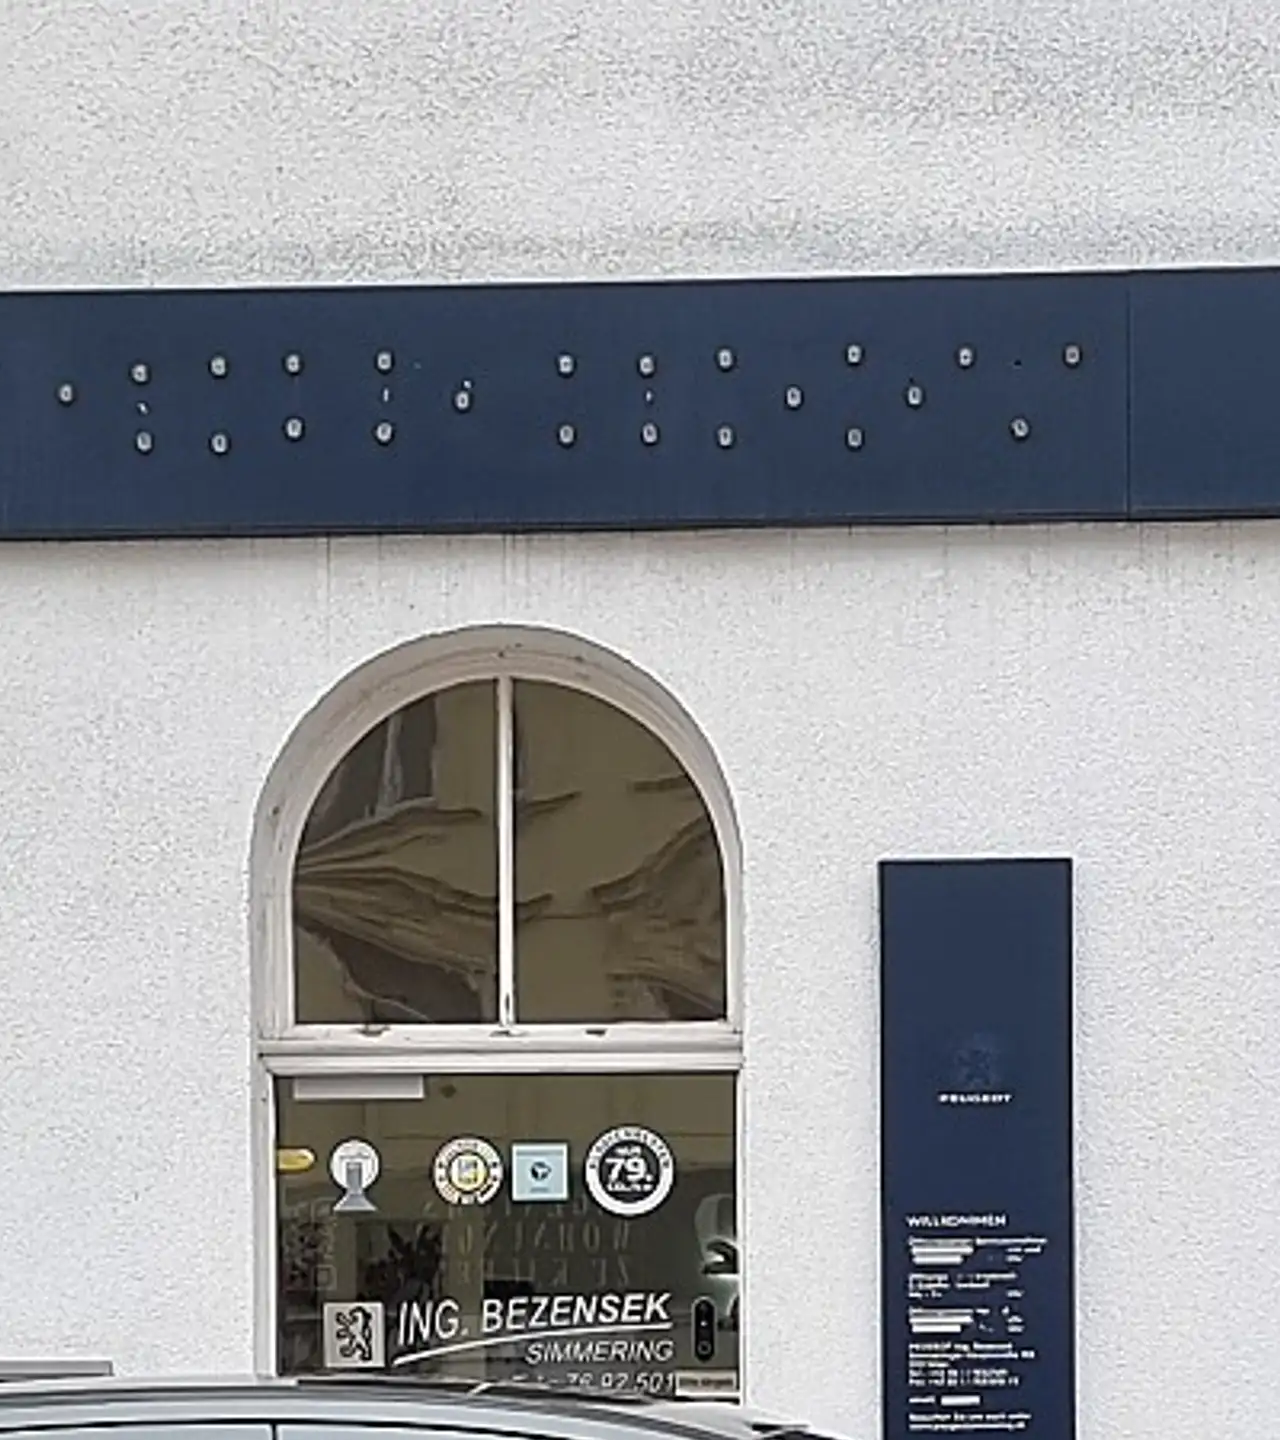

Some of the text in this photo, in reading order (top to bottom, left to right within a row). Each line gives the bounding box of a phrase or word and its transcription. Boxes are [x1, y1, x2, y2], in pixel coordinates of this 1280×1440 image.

[397, 1292, 672, 1346] ING. BEZENSEK
[525, 1340, 674, 1365] SIMMERING
